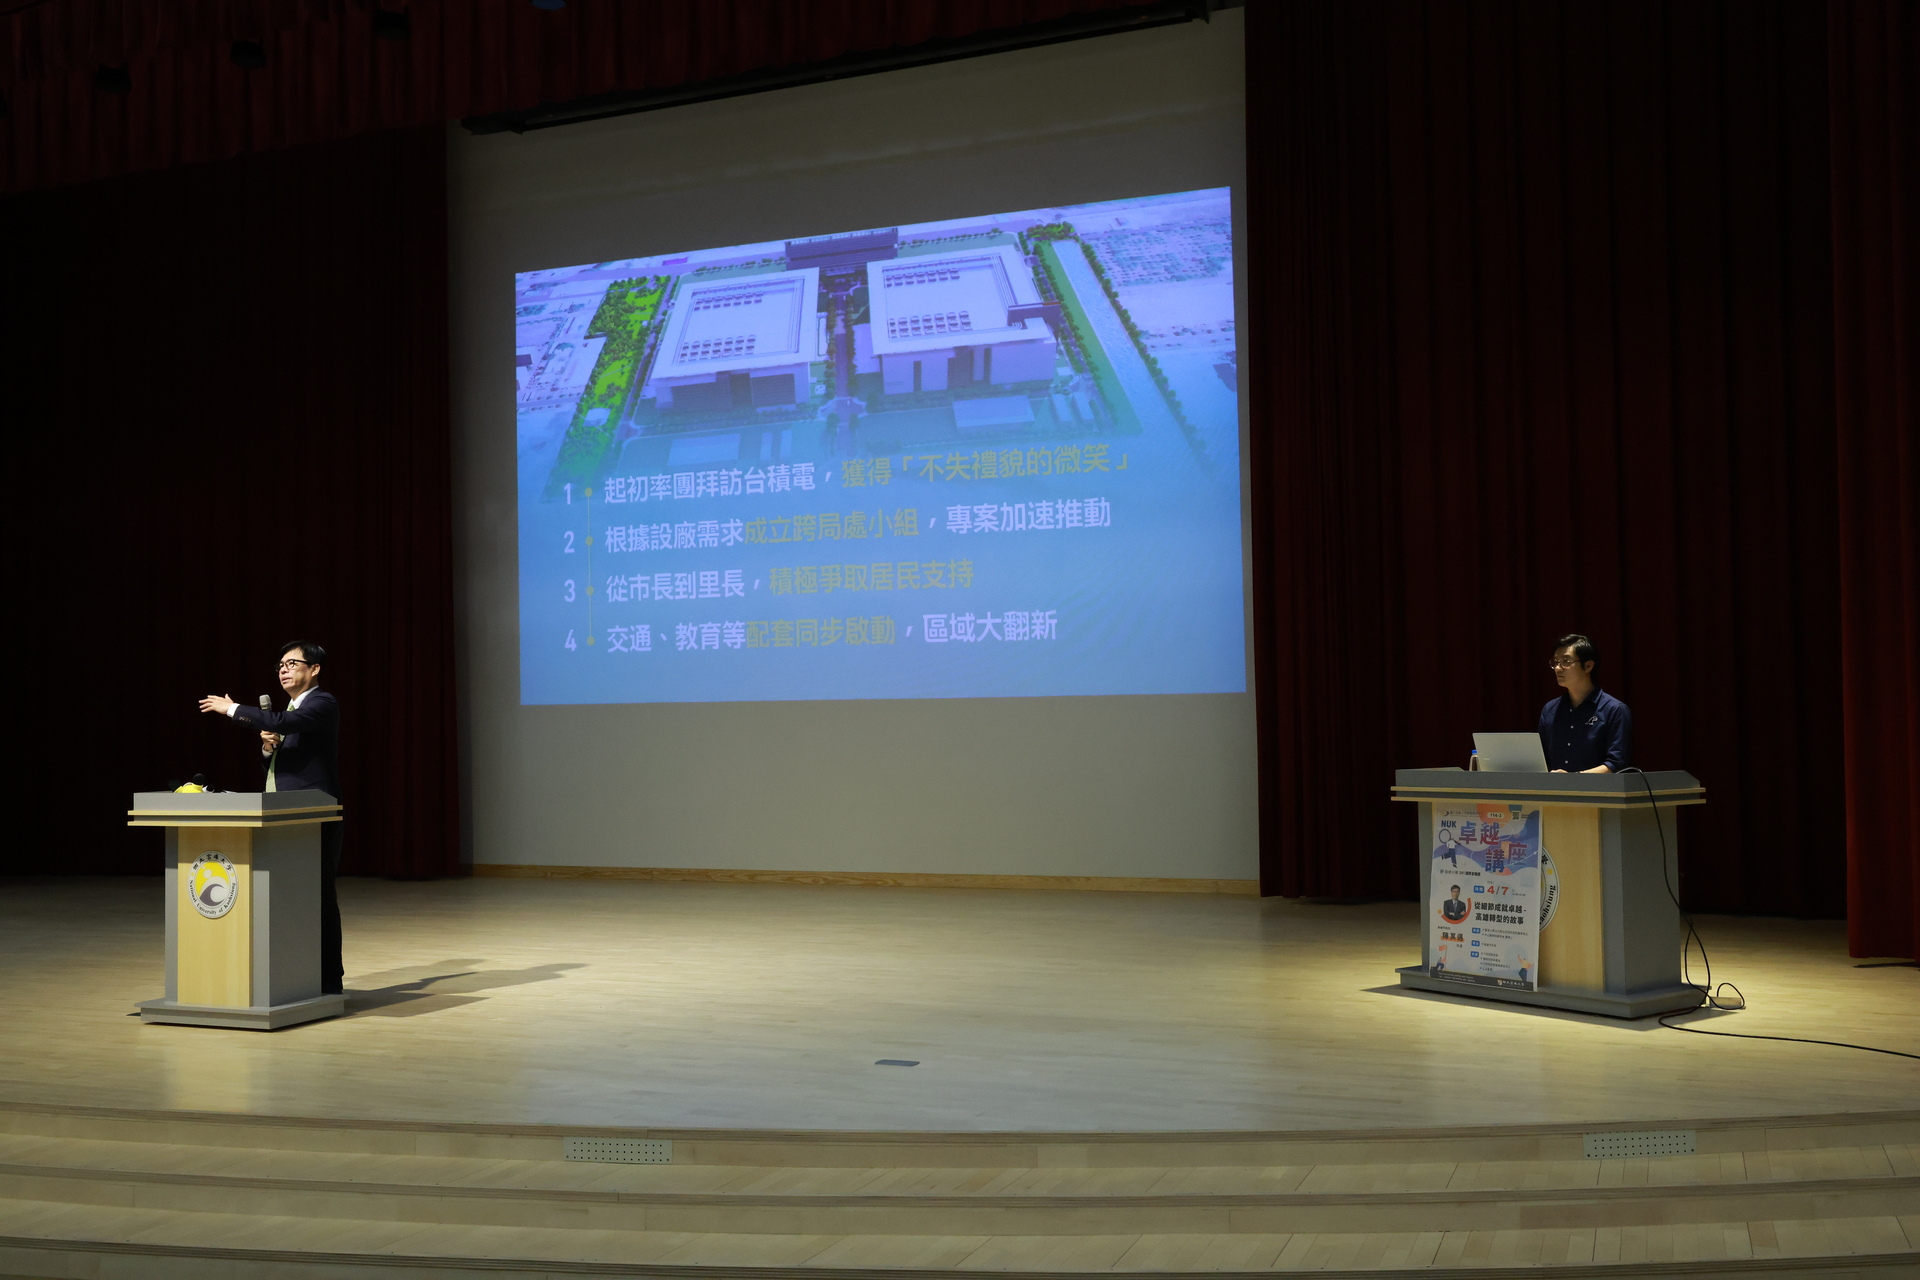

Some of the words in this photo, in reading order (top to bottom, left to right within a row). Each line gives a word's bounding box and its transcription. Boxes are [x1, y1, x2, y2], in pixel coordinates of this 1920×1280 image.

[563, 482, 572, 505] 1
[563, 530, 575, 553] 2
[563, 579, 576, 602] 3
[564, 629, 577, 651] 4
[1441, 820, 1457, 828] NUK
[1459, 821, 1500, 846] 卓越
[1487, 885, 1509, 896] 4/7
[1539, 885, 1556, 925] aohsiung
